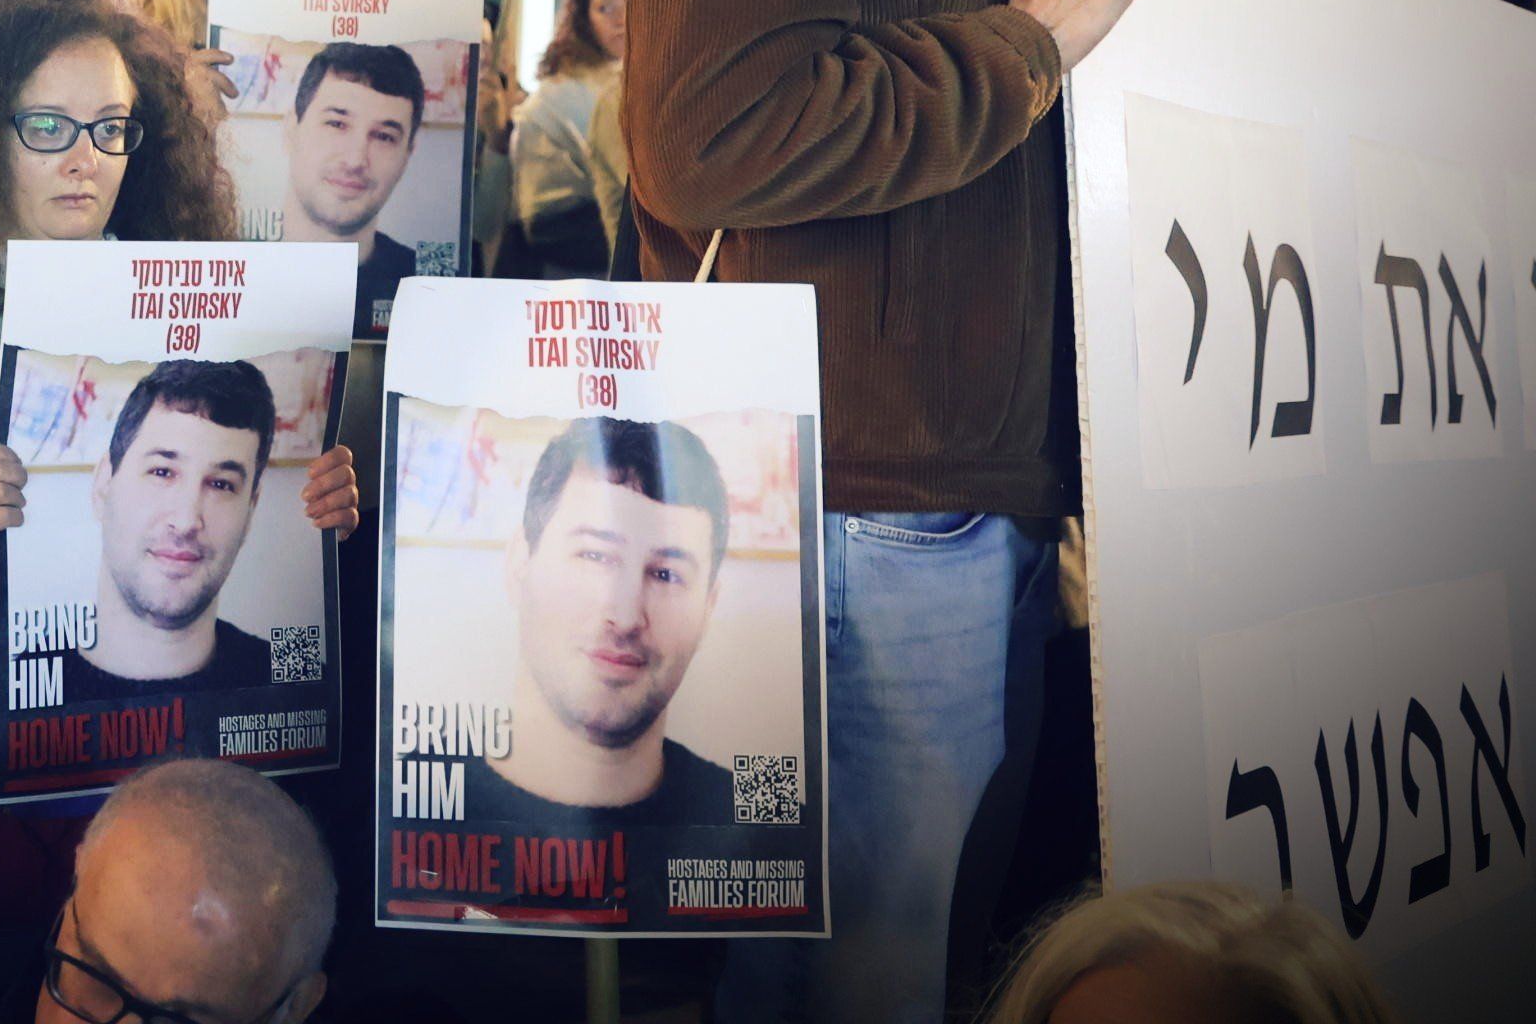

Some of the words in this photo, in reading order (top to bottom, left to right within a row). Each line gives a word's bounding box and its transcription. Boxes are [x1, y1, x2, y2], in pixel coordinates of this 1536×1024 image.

[331, 15, 359, 38] (38)
[131, 259, 203, 290] סבירסקי
[208, 259, 246, 287] איתי
[131, 292, 164, 319] ITAI
[168, 292, 242, 320] SVIRSKY
[525, 299, 610, 334] סבירסקי
[614, 302, 663, 334] איתי
[166, 322, 201, 354] (38)
[1164, 218, 1317, 452] מי
[1374, 239, 1498, 433] את
[528, 336, 568, 367] ITAI
[575, 336, 661, 371] SVIRSKY
[577, 372, 618, 411] (38)
[9, 601, 98, 657] BRING
[8, 656, 64, 711] HIM
[8, 713, 92, 771] HOME
[99, 696, 185, 762] NOW!
[219, 714, 266, 733] HOSTAGES
[267, 712, 286, 729] AND
[287, 708, 327, 728] MISSING
[394, 700, 513, 760] BRING
[219, 728, 278, 757] FAMILIES
[281, 725, 327, 752] FORUM
[392, 759, 465, 821] HIM
[1225, 672, 1527, 941] אפשר
[391, 829, 503, 894] HOME
[515, 831, 628, 899] NOW!
[667, 858, 728, 879] HOSTAGES
[730, 860, 753, 880] AND
[755, 860, 805, 880] MISSING
[668, 879, 744, 909] FAMILIES
[747, 880, 805, 909] FORUM
